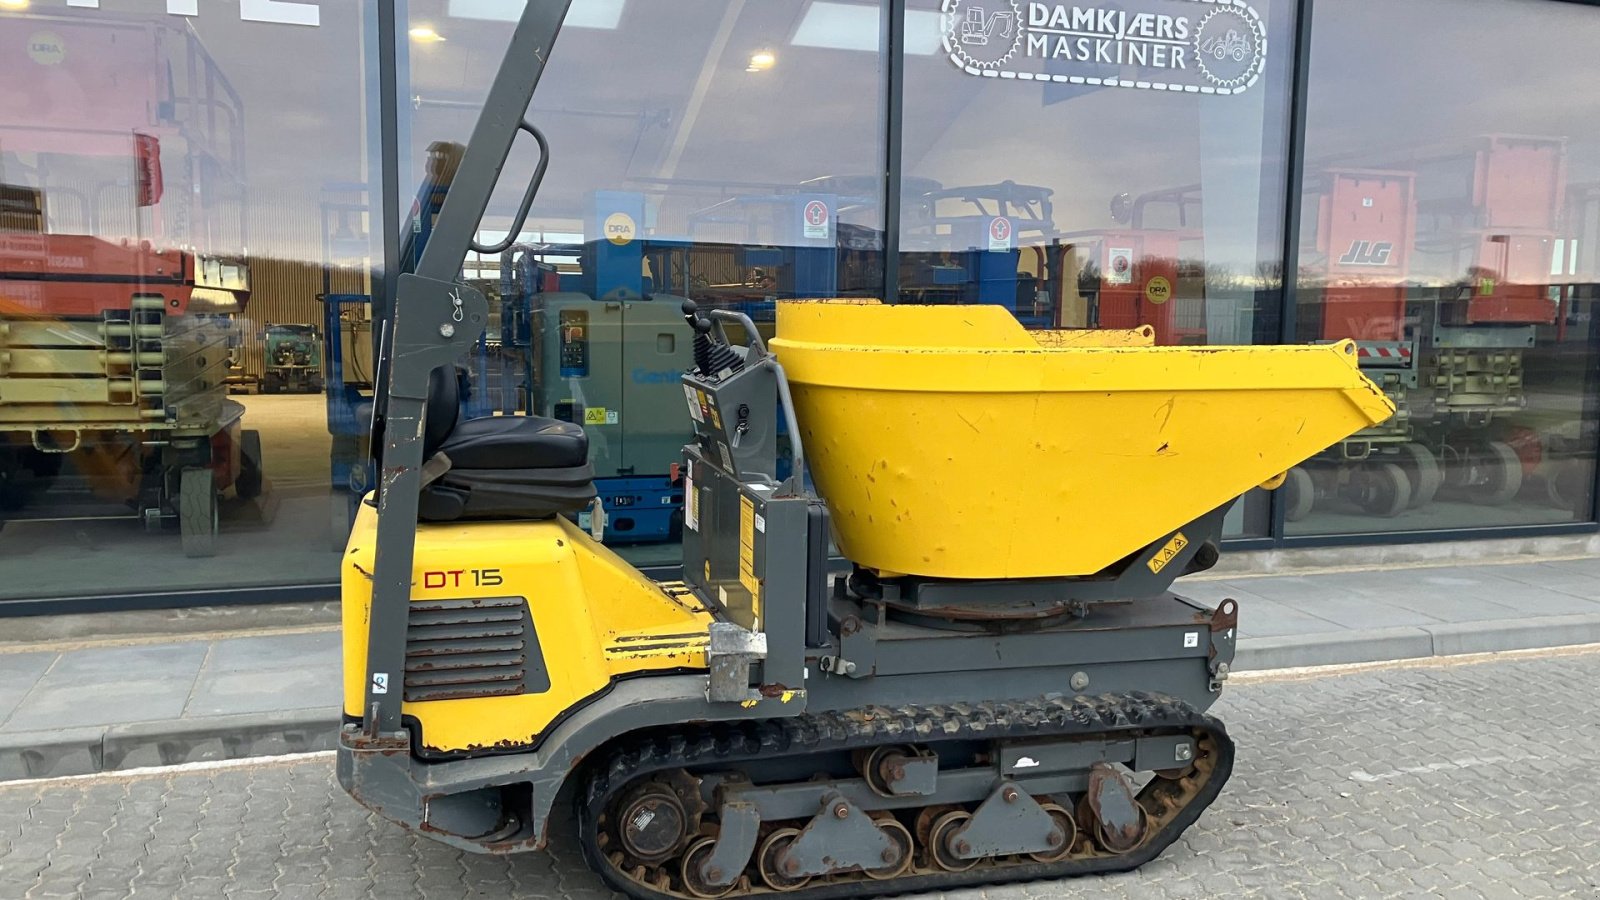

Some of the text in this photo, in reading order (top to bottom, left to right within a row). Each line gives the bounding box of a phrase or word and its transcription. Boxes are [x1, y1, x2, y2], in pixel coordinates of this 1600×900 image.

[1028, 2, 1189, 40] DAMKJÆRS
[1027, 33, 1186, 69] MASKINER
[608, 224, 630, 233] DRA
[1339, 240, 1393, 265] JLG
[1149, 286, 1167, 294] DRA
[424, 569, 503, 589] DT 15
